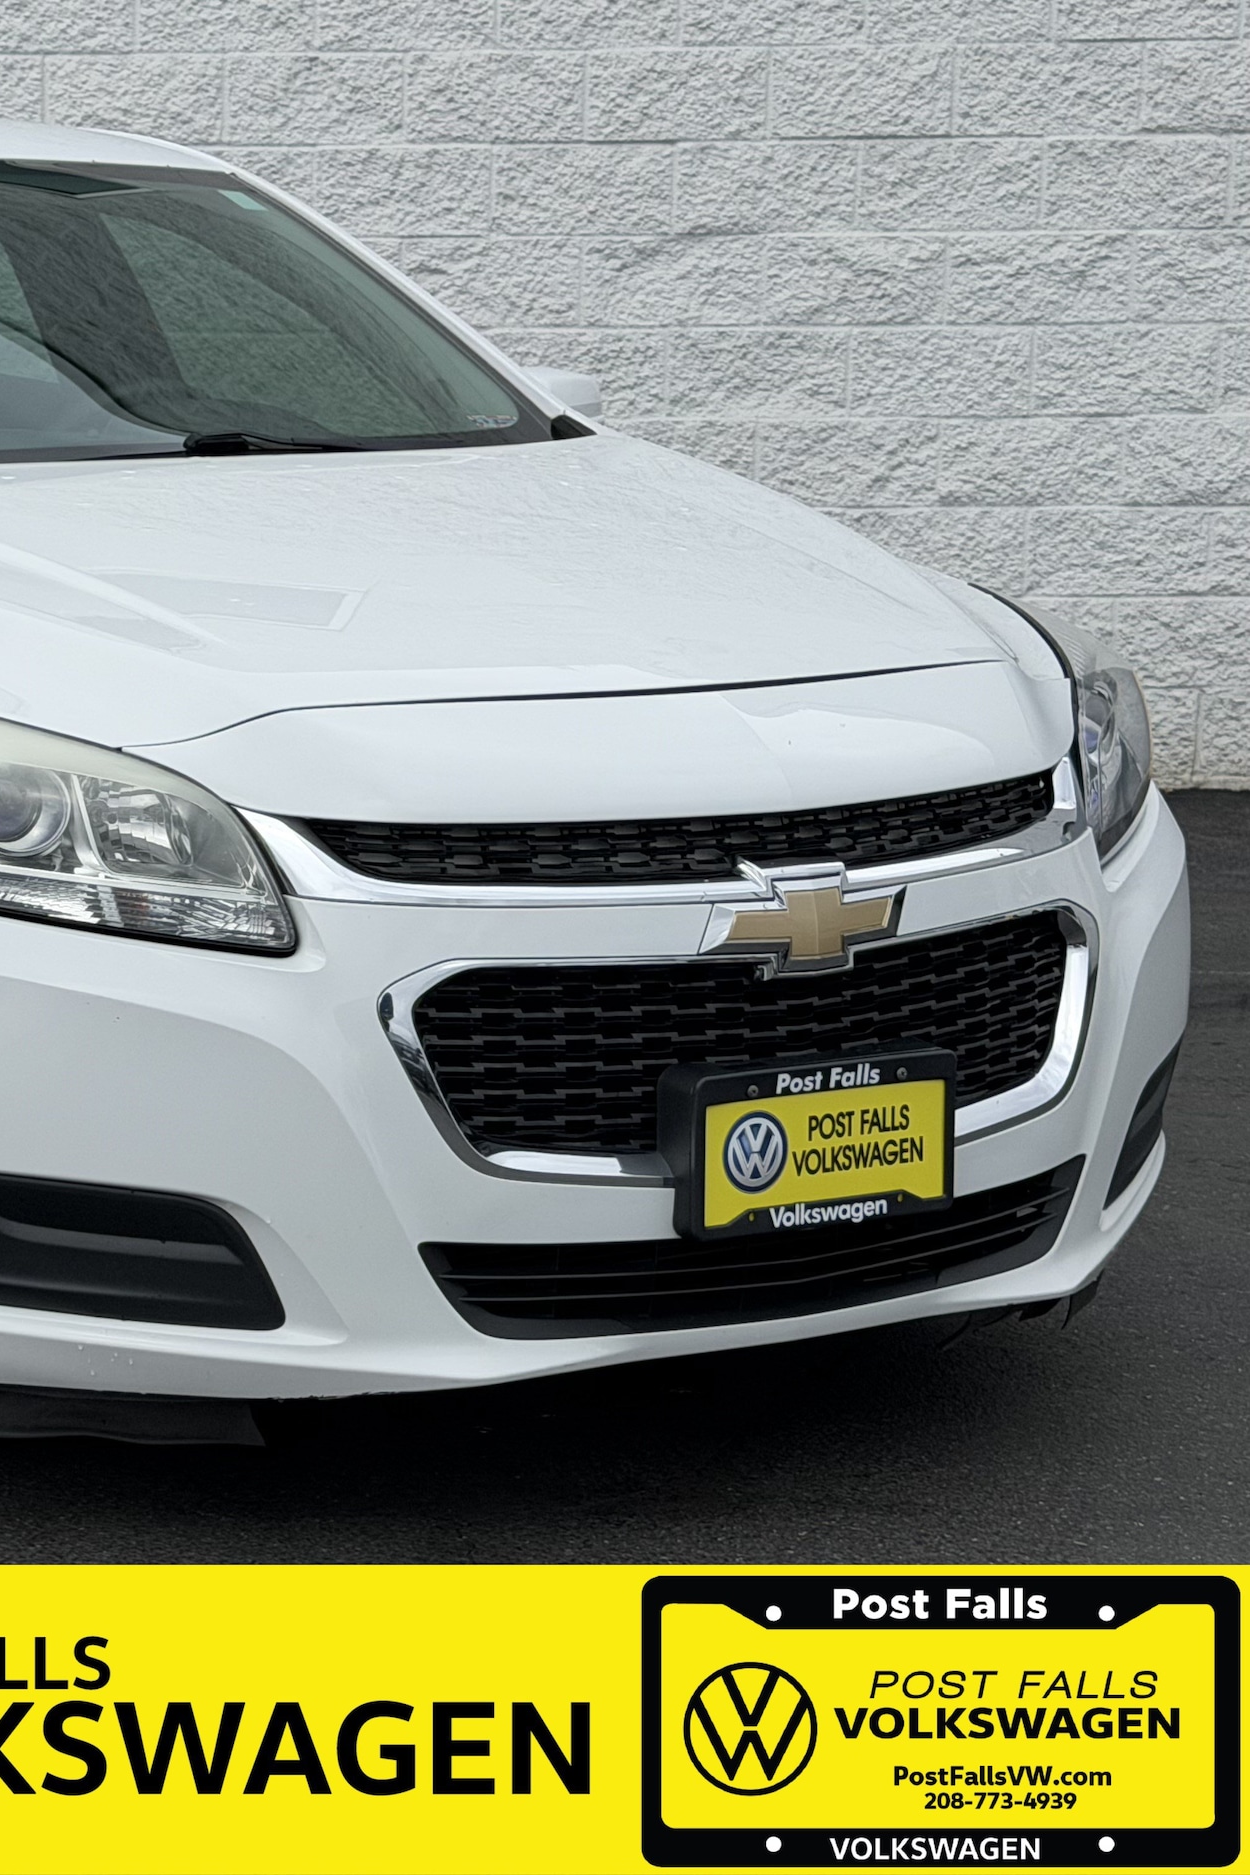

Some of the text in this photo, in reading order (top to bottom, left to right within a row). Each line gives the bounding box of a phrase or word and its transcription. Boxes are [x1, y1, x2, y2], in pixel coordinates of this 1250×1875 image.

[775, 1063, 881, 1095] Post Falls
[807, 1104, 910, 1142] POST FALLS
[727, 1116, 785, 1187] VW
[791, 1136, 924, 1177] VOLKSWAGEN
[769, 1198, 888, 1229] Volkswagen
